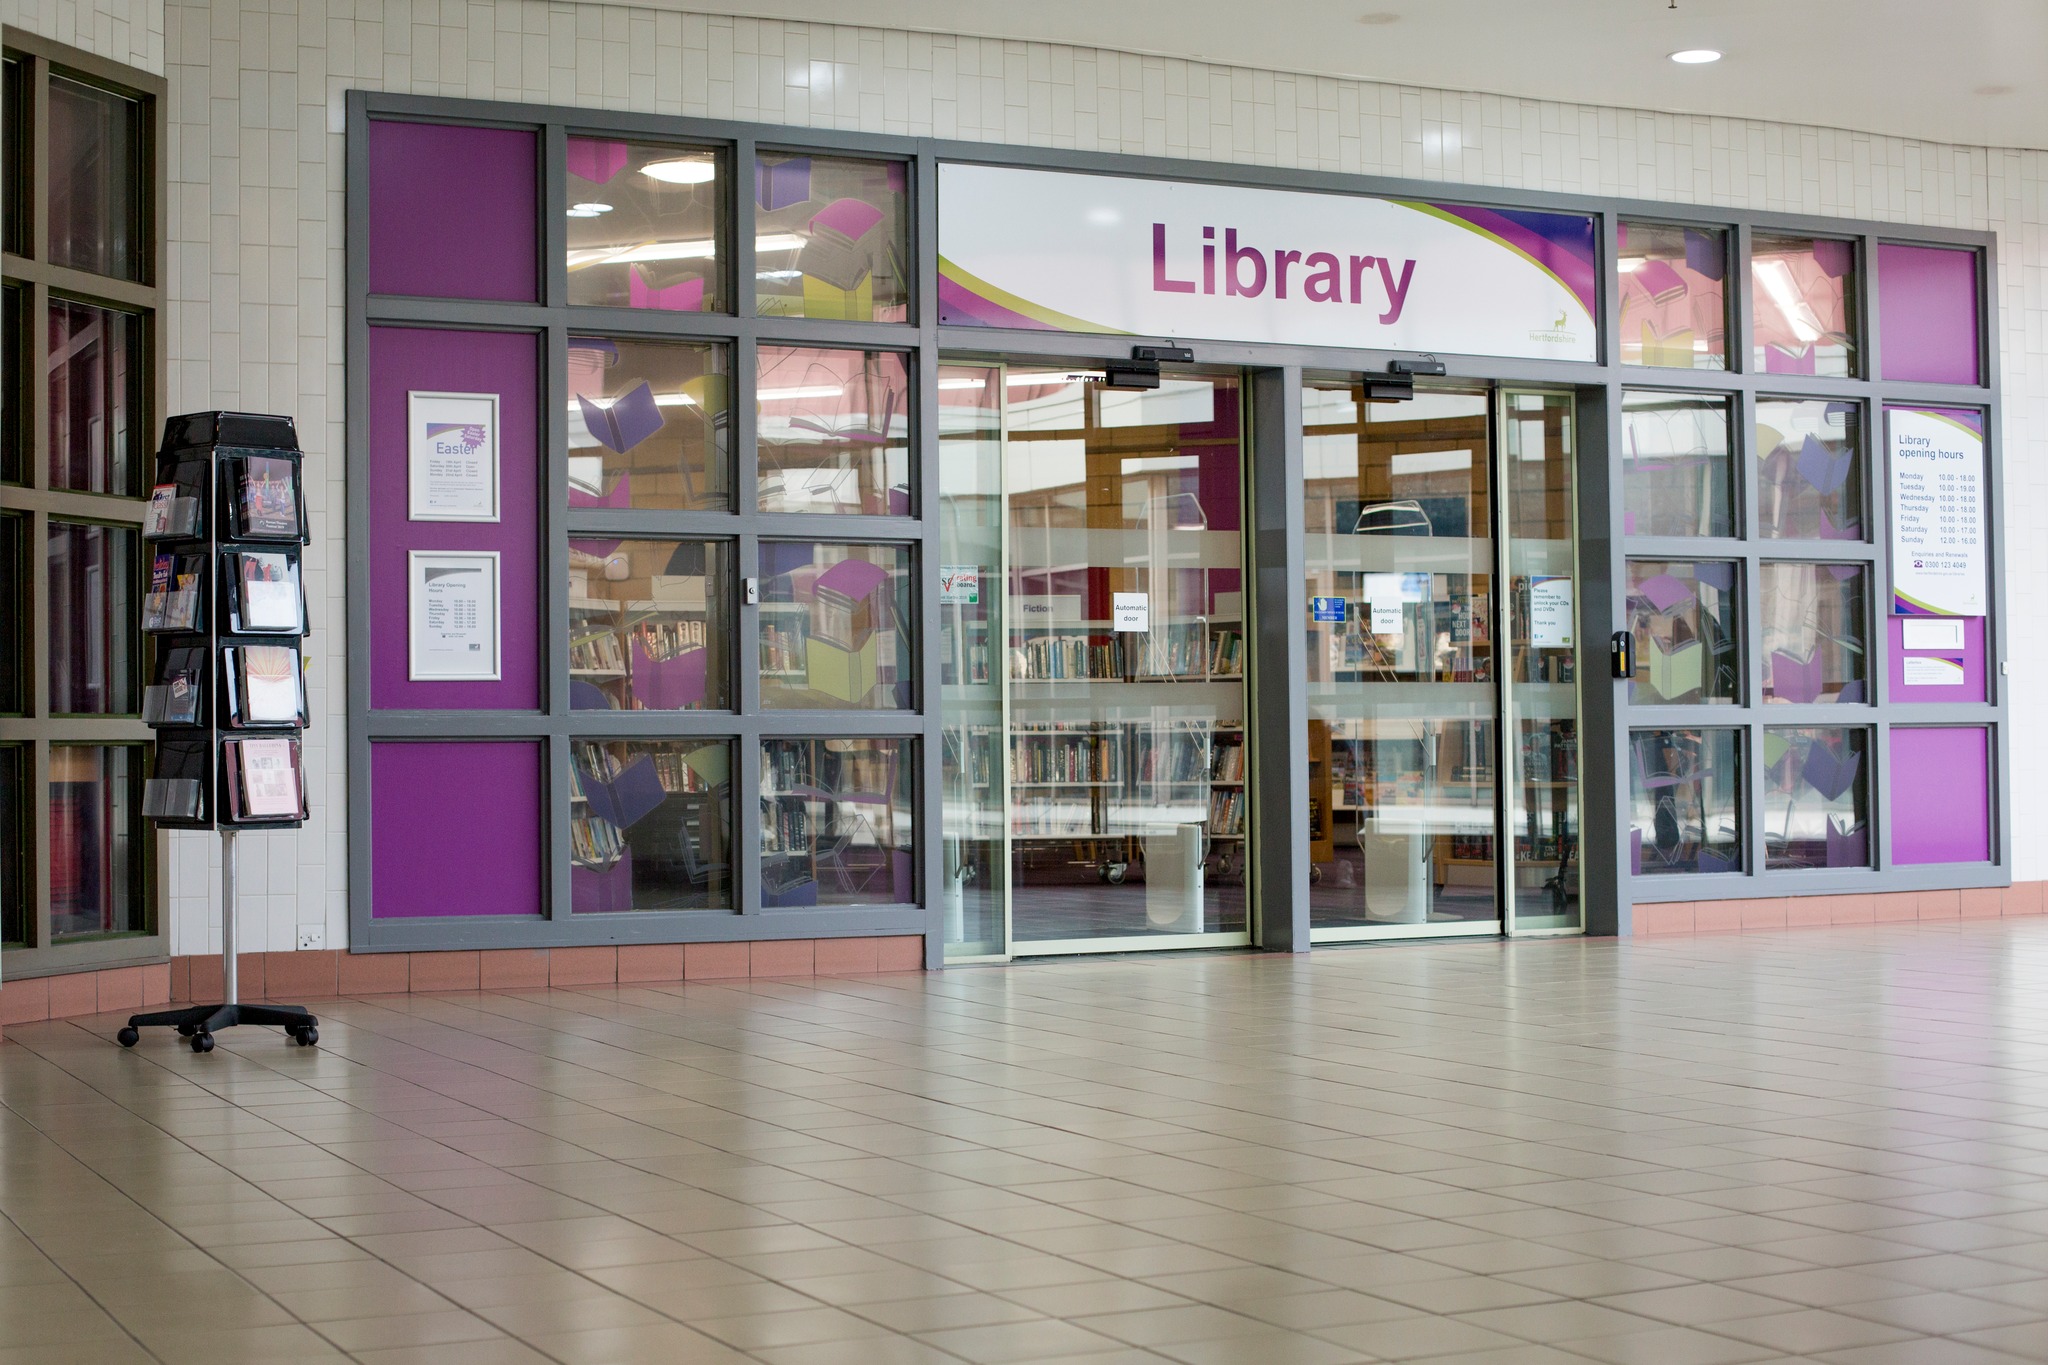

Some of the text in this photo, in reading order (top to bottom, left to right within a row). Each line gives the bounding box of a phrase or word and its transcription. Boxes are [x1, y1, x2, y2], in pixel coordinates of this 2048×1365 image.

[1153, 223, 1416, 325] Library
[1529, 332, 1576, 343] Hertfordshire
[1899, 434, 1930, 448] Library
[1899, 448, 1964, 460] opening hours
[1900, 472, 1923, 481] Monday
[1900, 482, 1924, 492] Tuesday
[1900, 494, 1935, 503] Wednesday
[1900, 504, 1928, 513] Thursday
[1901, 514, 1919, 523] Friday
[1901, 525, 1928, 534] Saturday
[1901, 536, 1924, 544] Sunday
[1023, 604, 1053, 612] Fiction
